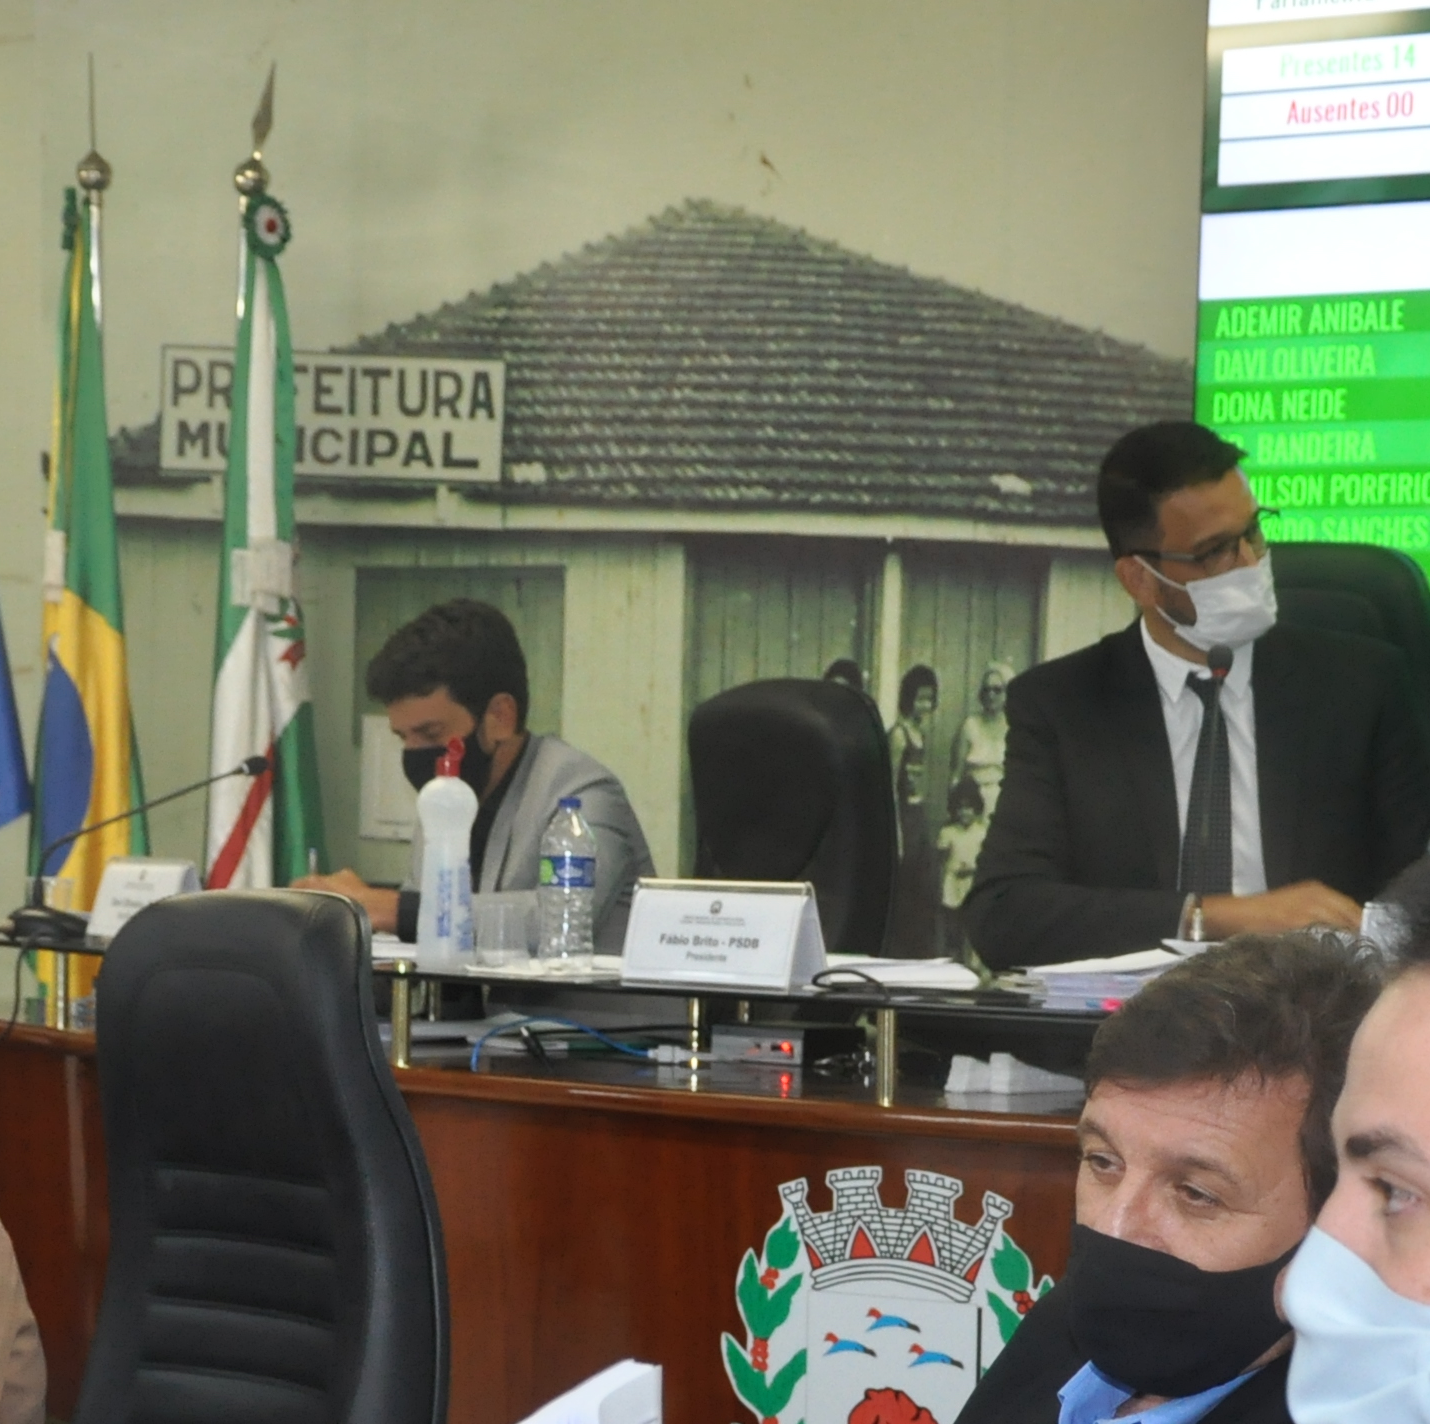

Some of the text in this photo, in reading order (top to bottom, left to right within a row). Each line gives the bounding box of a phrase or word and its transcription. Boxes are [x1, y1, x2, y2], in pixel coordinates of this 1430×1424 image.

[1280, 42, 1416, 78] Presentes 14
[1286, 91, 1414, 125] Ausentes 00
[1214, 304, 1303, 339] ADEMIR
[1308, 298, 1405, 335] ANIBALE
[1214, 348, 1267, 382] DAVI
[1273, 344, 1377, 380] OLIVEIRA
[172, 358, 495, 420] PREITURA
[1212, 390, 1275, 423] DONA
[1281, 387, 1347, 422] NEIDE
[177, 419, 479, 469] MICIPAL
[1256, 430, 1377, 465] BANDEIRA
[1250, 473, 1324, 507] ILSON
[1321, 515, 1430, 549] SANCHES
